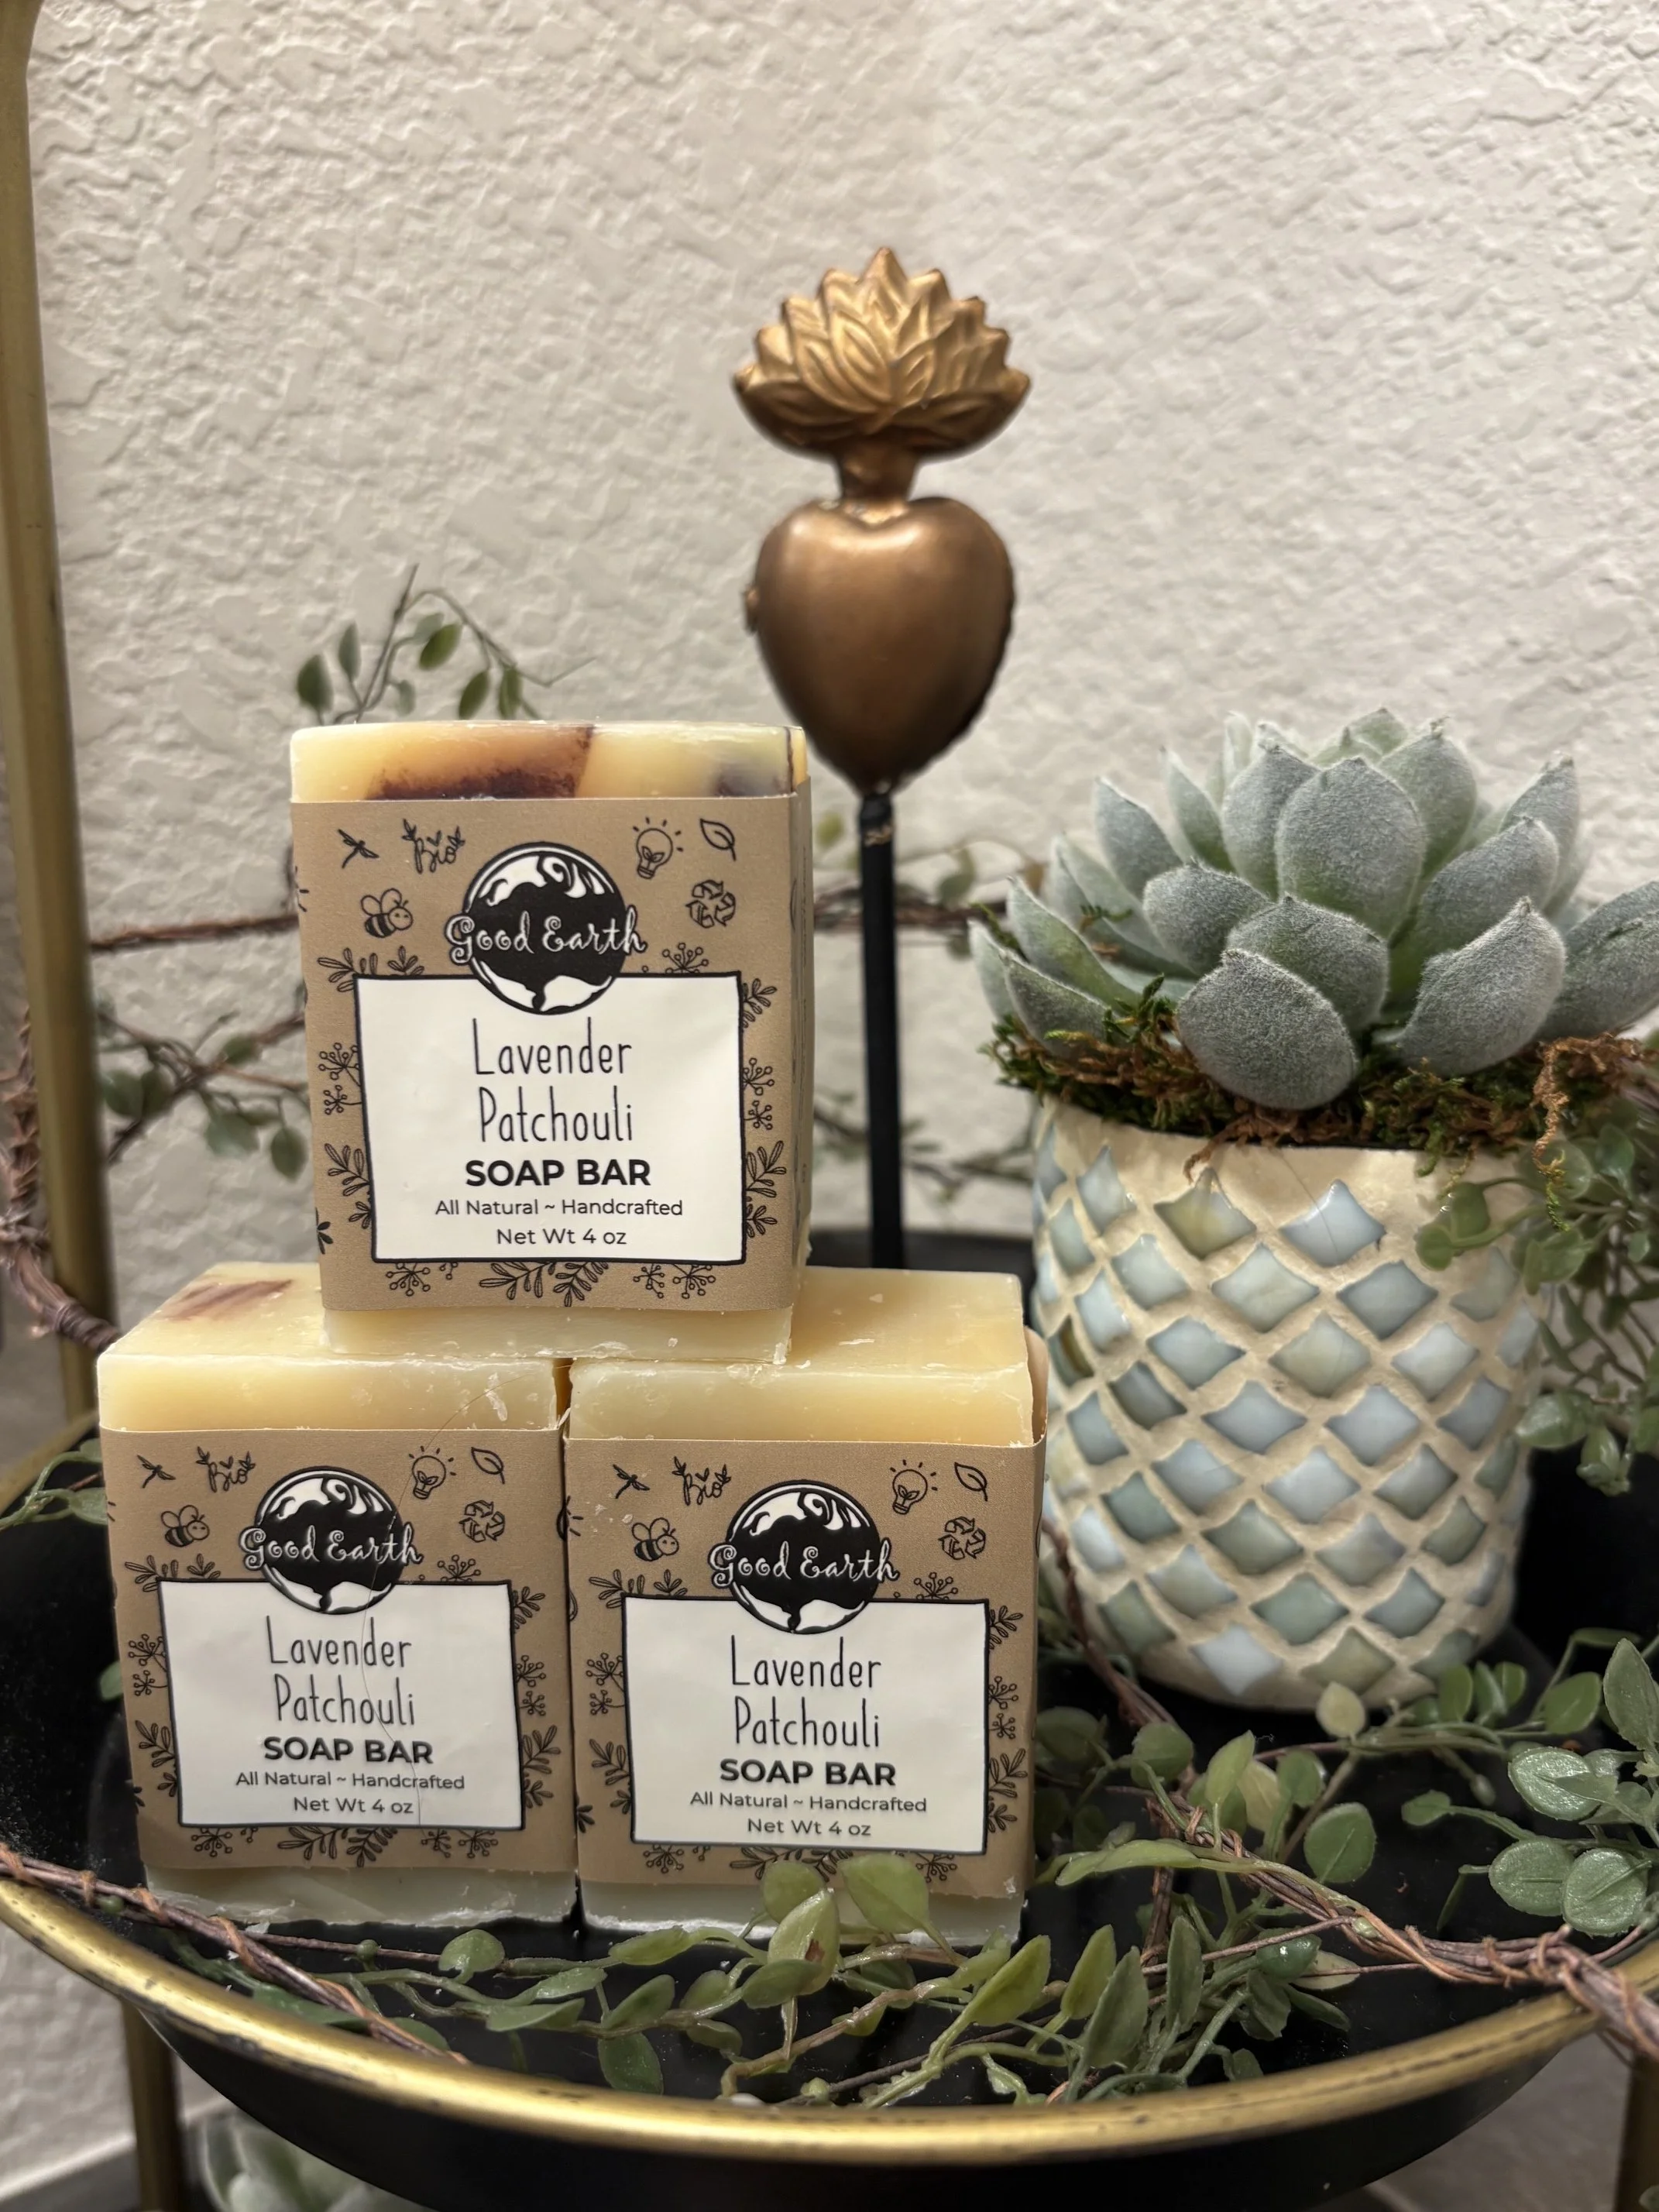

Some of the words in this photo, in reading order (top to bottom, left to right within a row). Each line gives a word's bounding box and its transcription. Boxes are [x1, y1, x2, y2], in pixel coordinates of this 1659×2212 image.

[445, 910, 535, 963] Good
[541, 905, 647, 954] Earth
[472, 1016, 633, 1076] Lavender
[478, 1084, 633, 1143] Patchouli
[465, 1159, 565, 1187] SOAP
[576, 1159, 651, 1187] BAR
[434, 1199, 459, 1215] All
[465, 1198, 539, 1215] Natural
[562, 1197, 683, 1216] Handcrafted
[496, 1228, 537, 1245] Net
[541, 1228, 576, 1245] Wt
[582, 1228, 597, 1244] 4
[603, 1231, 627, 1245] oz
[239, 1524, 321, 1569] Good
[325, 1523, 424, 1565] Earth
[709, 1540, 792, 1587] Good
[799, 1539, 899, 1582] Earth
[266, 1615, 412, 1668] Lavender
[730, 1634, 882, 1688] Lavender
[273, 1673, 415, 1726] Patchouli
[734, 1695, 879, 1748] Patchouli
[263, 1736, 354, 1762] SOAP
[364, 1739, 434, 1765] BAR
[235, 1771, 259, 1786] All
[264, 1771, 331, 1786] Natural
[352, 1773, 465, 1790] Handcrafted
[720, 1758, 814, 1785] SOAP
[825, 1761, 896, 1787] BAR
[294, 1796, 330, 1812] Net
[335, 1798, 366, 1813] Wt
[371, 1798, 386, 1813] 4
[390, 1802, 414, 1815] oz
[689, 1791, 713, 1805] All
[720, 1792, 788, 1809] Natural
[809, 1795, 927, 1812] Handcrafted
[747, 1818, 785, 1834] Net
[791, 1819, 822, 1835] Wt
[828, 1821, 843, 1836] 4
[848, 1824, 871, 1836] oz
